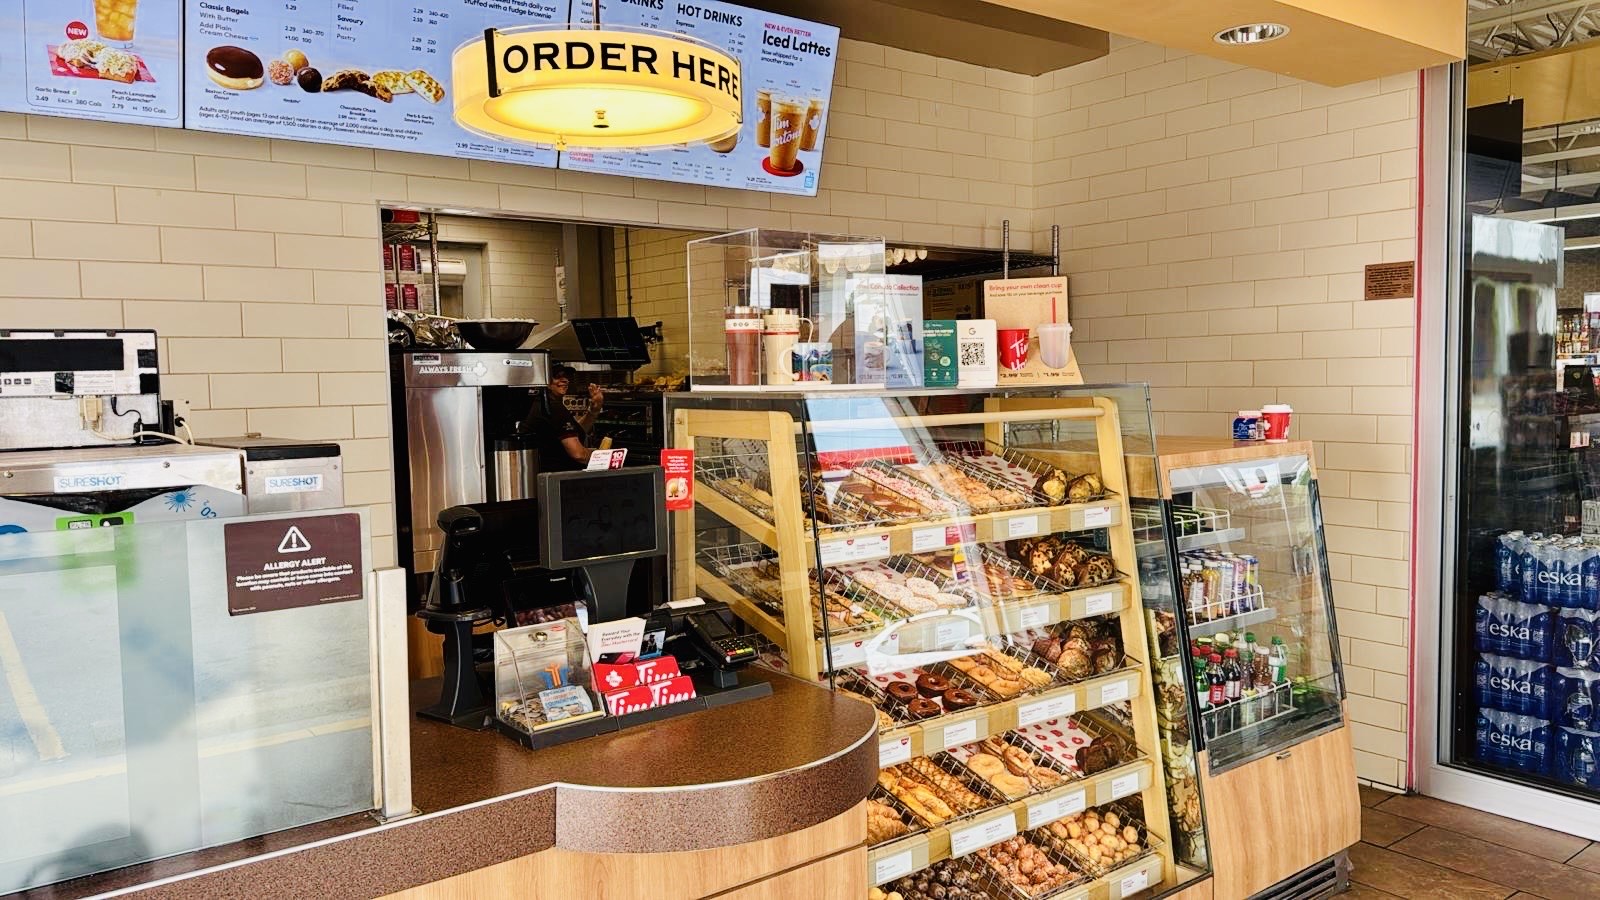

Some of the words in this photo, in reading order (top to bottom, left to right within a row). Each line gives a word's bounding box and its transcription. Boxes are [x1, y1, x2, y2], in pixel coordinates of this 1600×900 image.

[200, 2, 224, 12] Classic
[226, 4, 250, 16] Bagels
[337, 2, 354, 11] Filled
[464, 0, 488, 8] stuffed
[488, 2, 502, 10] with
[508, 6, 526, 16] fudge
[528, 9, 552, 20] brownie
[528, 2, 543, 12] daily
[200, 12, 216, 21] With
[217, 14, 239, 23] Butter
[337, 14, 364, 26] Savoury
[677, 3, 702, 18] HOT
[703, 8, 743, 27] DRINKS
[68, 26, 88, 36] NEW
[200, 22, 214, 30] Add
[216, 24, 232, 32] Plain
[337, 24, 352, 32] Twist
[781, 26, 794, 34] EVEN
[794, 28, 812, 37] BETTER
[200, 28, 224, 38] Cream
[224, 32, 250, 40] Cheese
[336, 34, 356, 42] Pastry
[762, 30, 791, 49] Iced
[792, 36, 831, 58] Lattes
[772, 51, 792, 60] whipped
[503, 41, 659, 76] ORDER
[672, 50, 740, 101] HERE
[989, 284, 1005, 292] Bring
[419, 365, 450, 374] ALWAYS
[612, 451, 624, 459] 10
[59, 475, 122, 489] SURESHOT
[270, 476, 318, 488] SURESHOT
[264, 560, 301, 571] ALLERGY
[301, 557, 327, 566] ALERT
[1538, 570, 1582, 586] eska
[1490, 623, 1530, 640] eska
[1490, 676, 1532, 694] eska
[1490, 731, 1532, 751] eska
